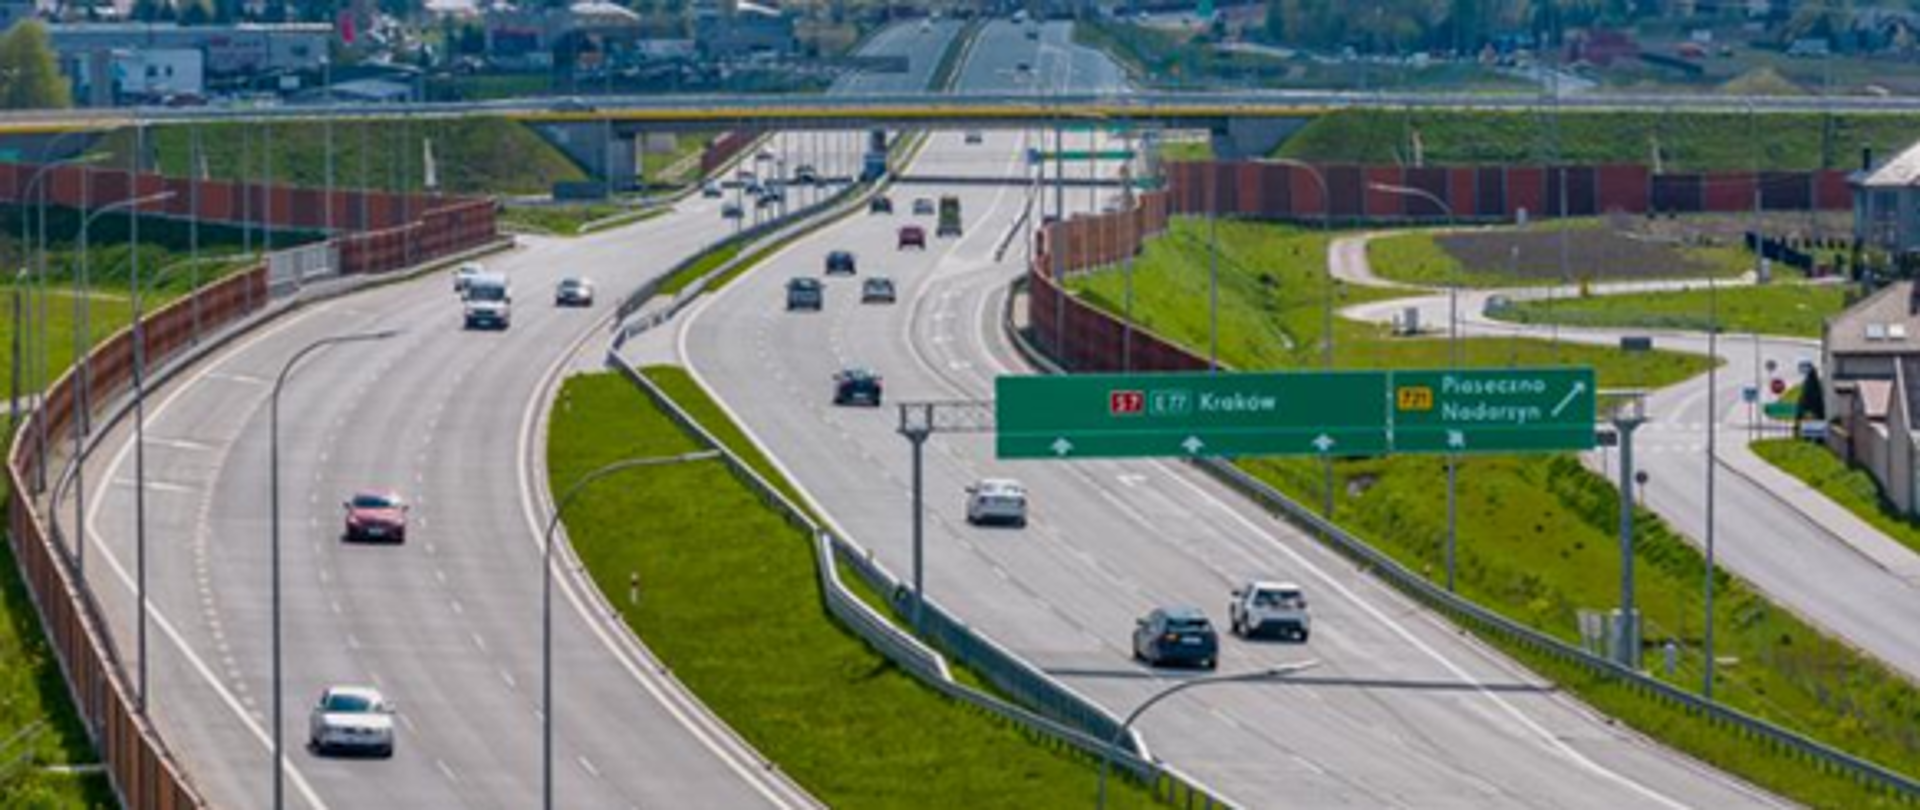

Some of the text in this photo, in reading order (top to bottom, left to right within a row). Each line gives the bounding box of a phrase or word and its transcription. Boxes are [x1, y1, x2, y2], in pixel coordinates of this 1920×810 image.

[1441, 375, 1546, 394] Piaseczno
[1200, 391, 1276, 411] Kraków
[1441, 402, 1542, 424] Nadarzyn
